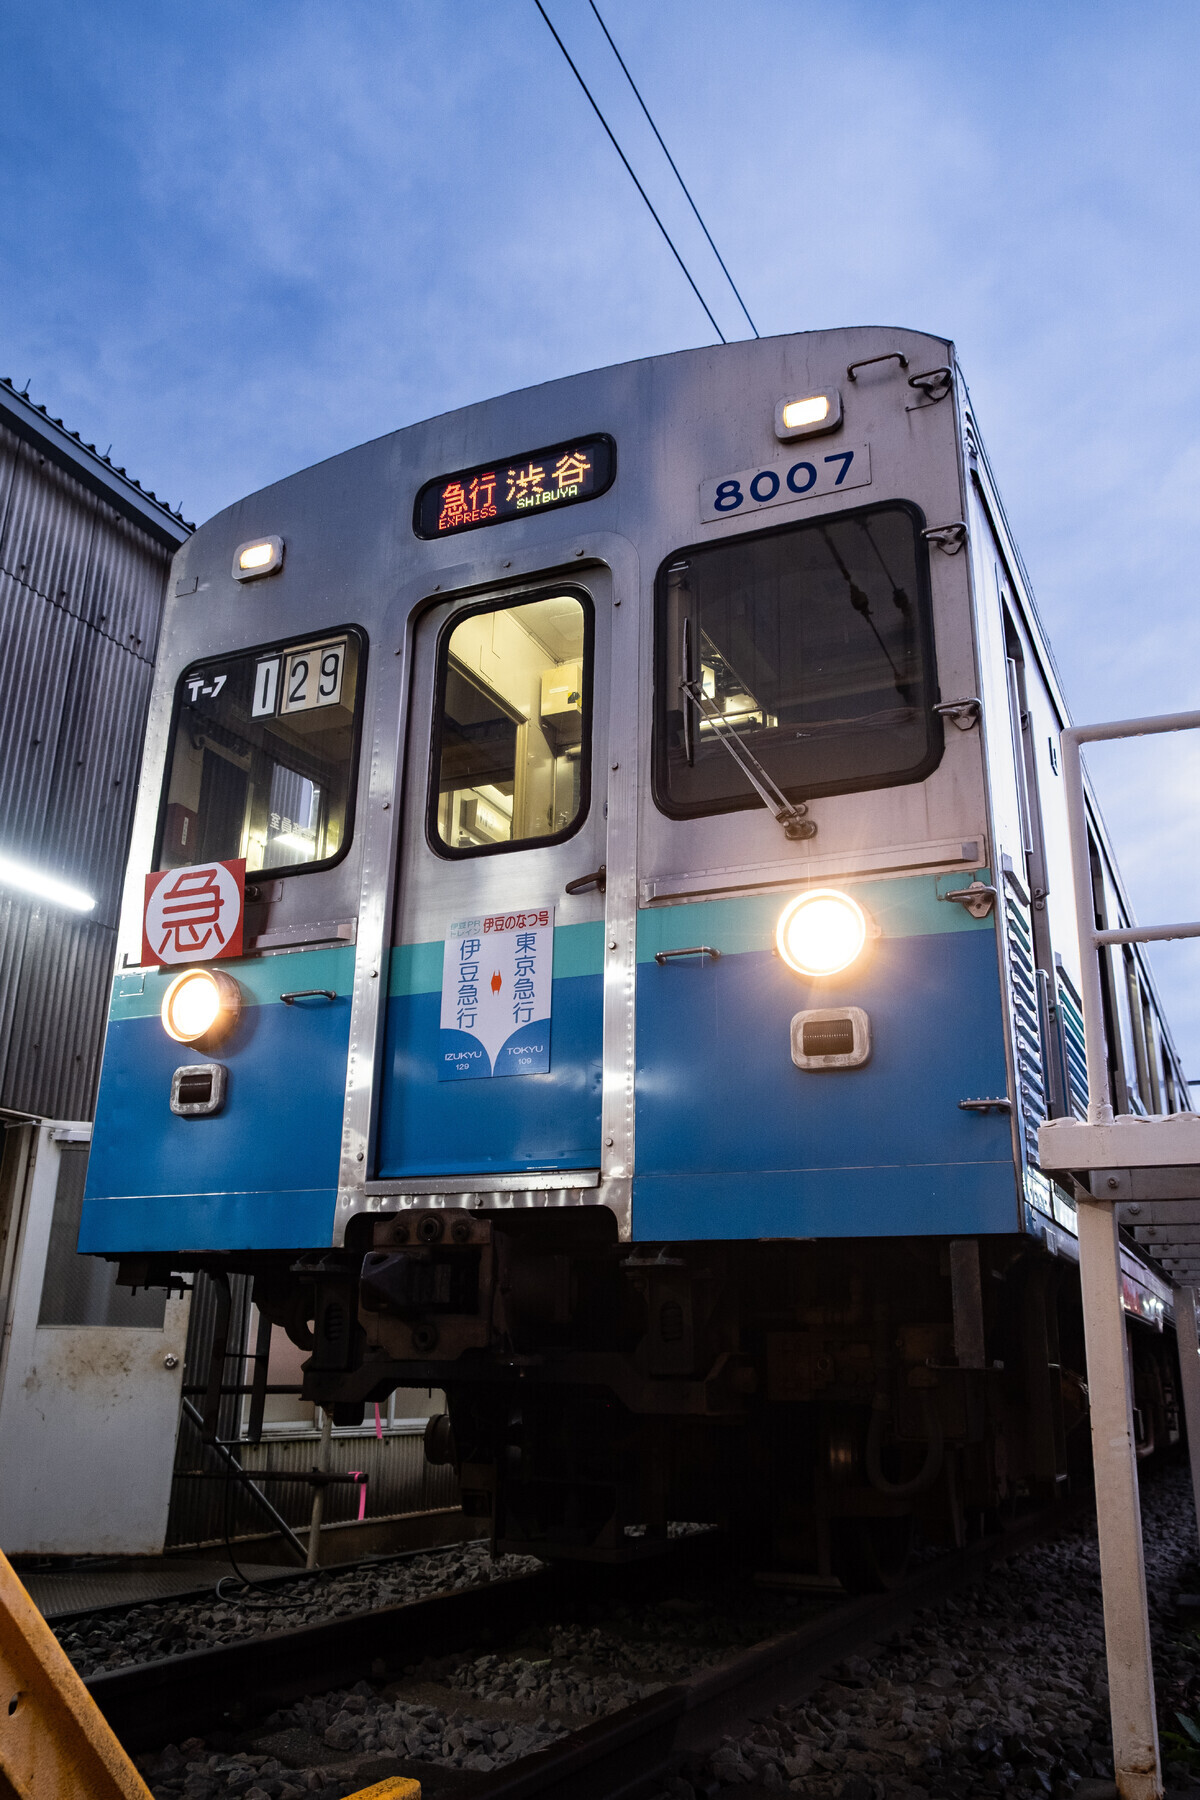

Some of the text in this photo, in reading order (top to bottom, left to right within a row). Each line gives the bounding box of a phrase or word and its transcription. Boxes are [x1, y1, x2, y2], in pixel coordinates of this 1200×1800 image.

[439, 450, 591, 519] 急行 渋谷
[714, 451, 855, 512] 8007
[516, 485, 578, 509] SHIBUYA
[438, 506, 497, 530] EXPRESS
[188, 674, 228, 702] T-7
[158, 868, 226, 955] 急
[483, 910, 549, 933] 伊豆のなつ号
[456, 938, 481, 1029] 伊豆急行
[512, 932, 537, 1024] 東京急行
[444, 1051, 482, 1061] IZUKYU
[506, 1045, 543, 1055] TOKYU
[456, 1063, 469, 1071] 129
